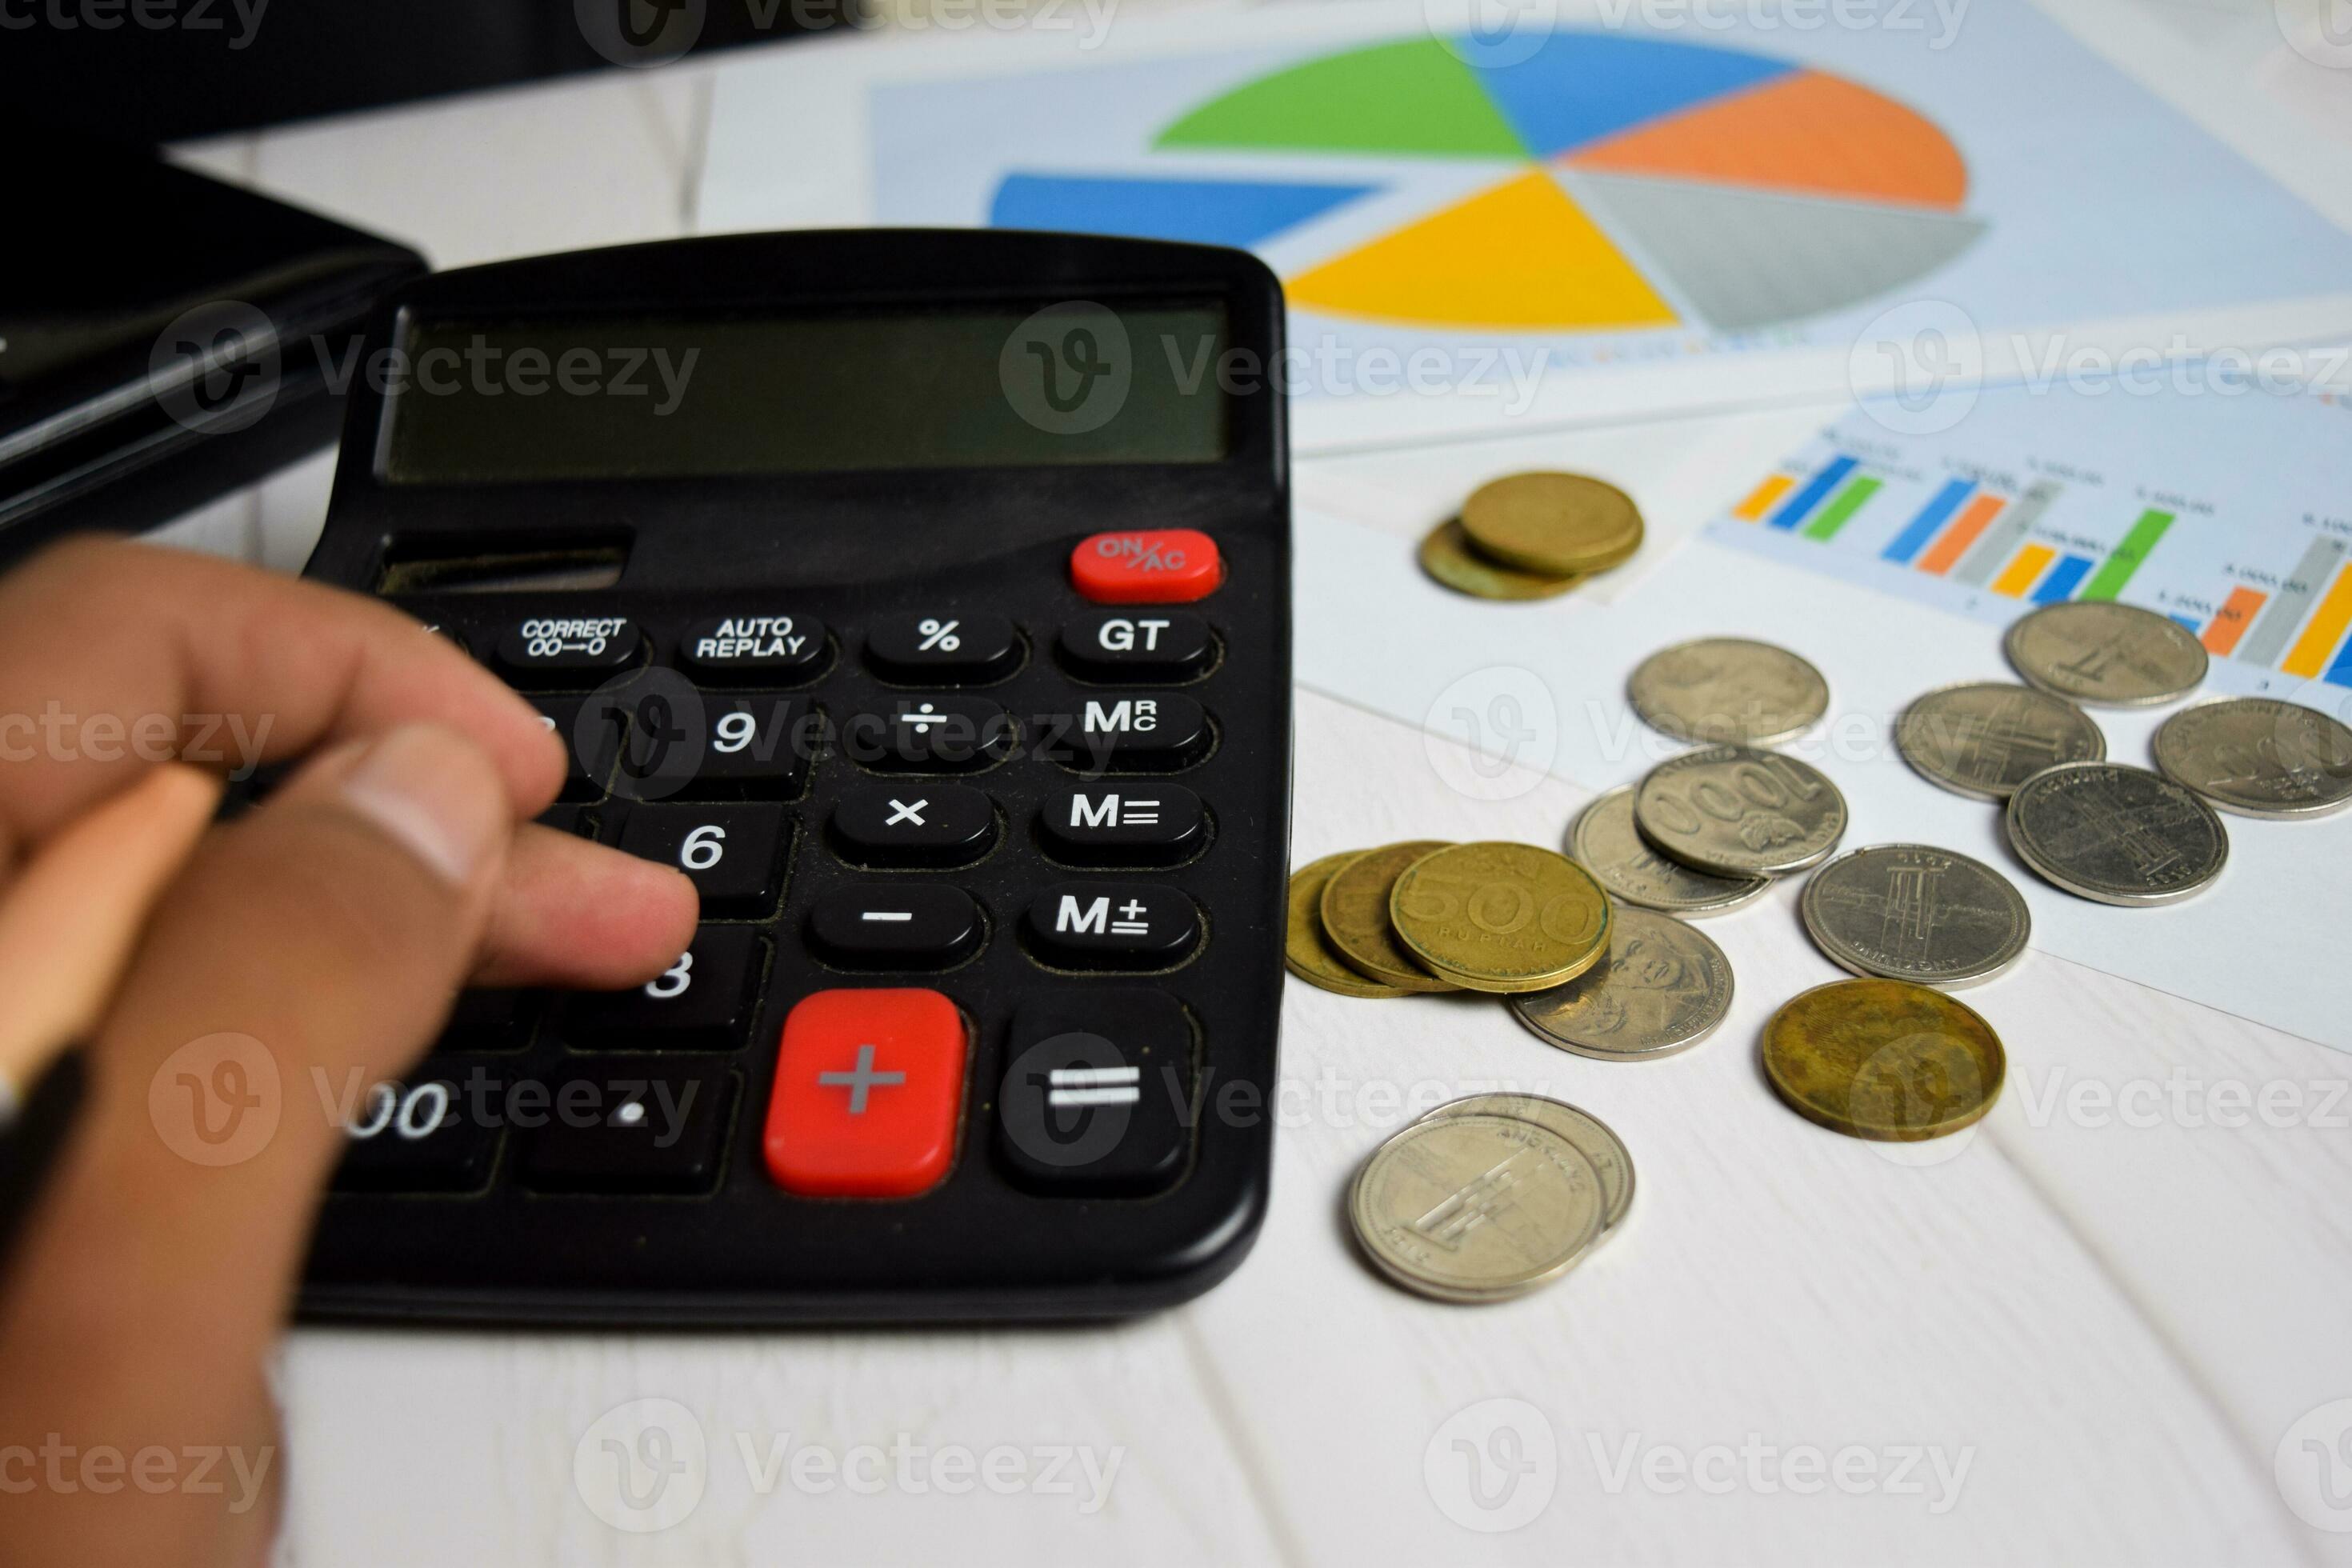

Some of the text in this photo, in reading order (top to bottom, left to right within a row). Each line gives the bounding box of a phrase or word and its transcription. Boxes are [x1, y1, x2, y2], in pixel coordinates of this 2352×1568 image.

[1096, 538, 1186, 572] ON/AC
[522, 618, 627, 638] CORRECT
[715, 617, 794, 638] AUTO
[1098, 618, 1170, 651] GT
[696, 636, 806, 658] REPLAY
[713, 712, 757, 753] 9
[680, 824, 726, 870] 6
[1398, 869, 1603, 946] 500
[645, 950, 694, 999] 3
